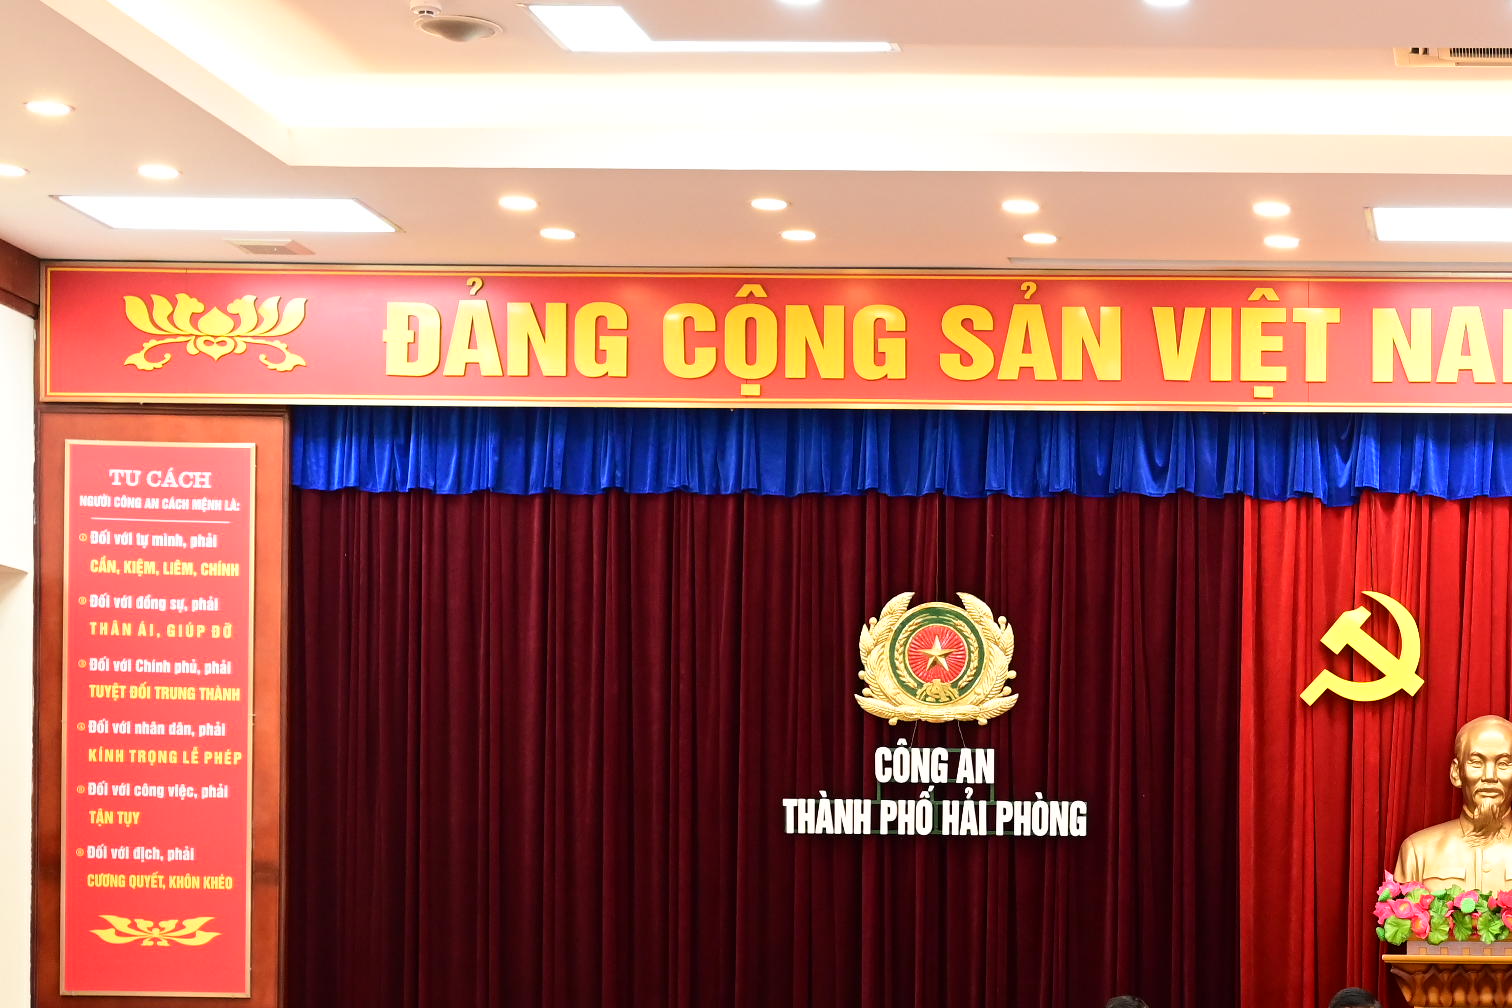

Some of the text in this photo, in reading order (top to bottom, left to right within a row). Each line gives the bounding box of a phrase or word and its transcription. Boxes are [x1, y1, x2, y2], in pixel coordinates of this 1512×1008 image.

[382, 277, 628, 377] ĐẢNG
[662, 283, 907, 396] CỘNG
[939, 282, 1123, 381] SẢN
[1151, 288, 1340, 398] VIỆT
[146, 467, 212, 488] CÁCH
[114, 494, 142, 509] CÔNG
[144, 498, 160, 509] AN
[162, 496, 190, 510] CÁCH
[224, 498, 240, 511] LÀ:
[90, 529, 111, 545] Đối
[114, 531, 133, 545] với
[152, 533, 187, 549] mình,
[190, 532, 218, 549] phải
[124, 558, 160, 576] KIỆM,
[163, 559, 198, 577] LIÊM,
[201, 560, 240, 577] CHÍNH
[90, 620, 132, 636] THÂN
[138, 621, 161, 638] ÁI,
[167, 621, 206, 638] GIÚP
[89, 683, 127, 701] TUYỆT
[130, 683, 151, 699] ĐỐI
[154, 686, 196, 700] TRUNG
[88, 719, 226, 737] Đối với nhân dân, phải
[89, 746, 124, 763] KÍNH
[129, 749, 178, 766] TRỌNG
[204, 749, 242, 765] PHÉP
[875, 738, 995, 784] CÔNG AN
[89, 808, 140, 827] TẬN TỤY
[783, 785, 1087, 837] THÀNH PHỐ HẢI PHÒNG
[87, 843, 195, 863] Đối với dịch, phải
[88, 873, 126, 888] CƯƠNG
[129, 871, 166, 890] QUYẾT,
[169, 873, 200, 889] KHÔN
